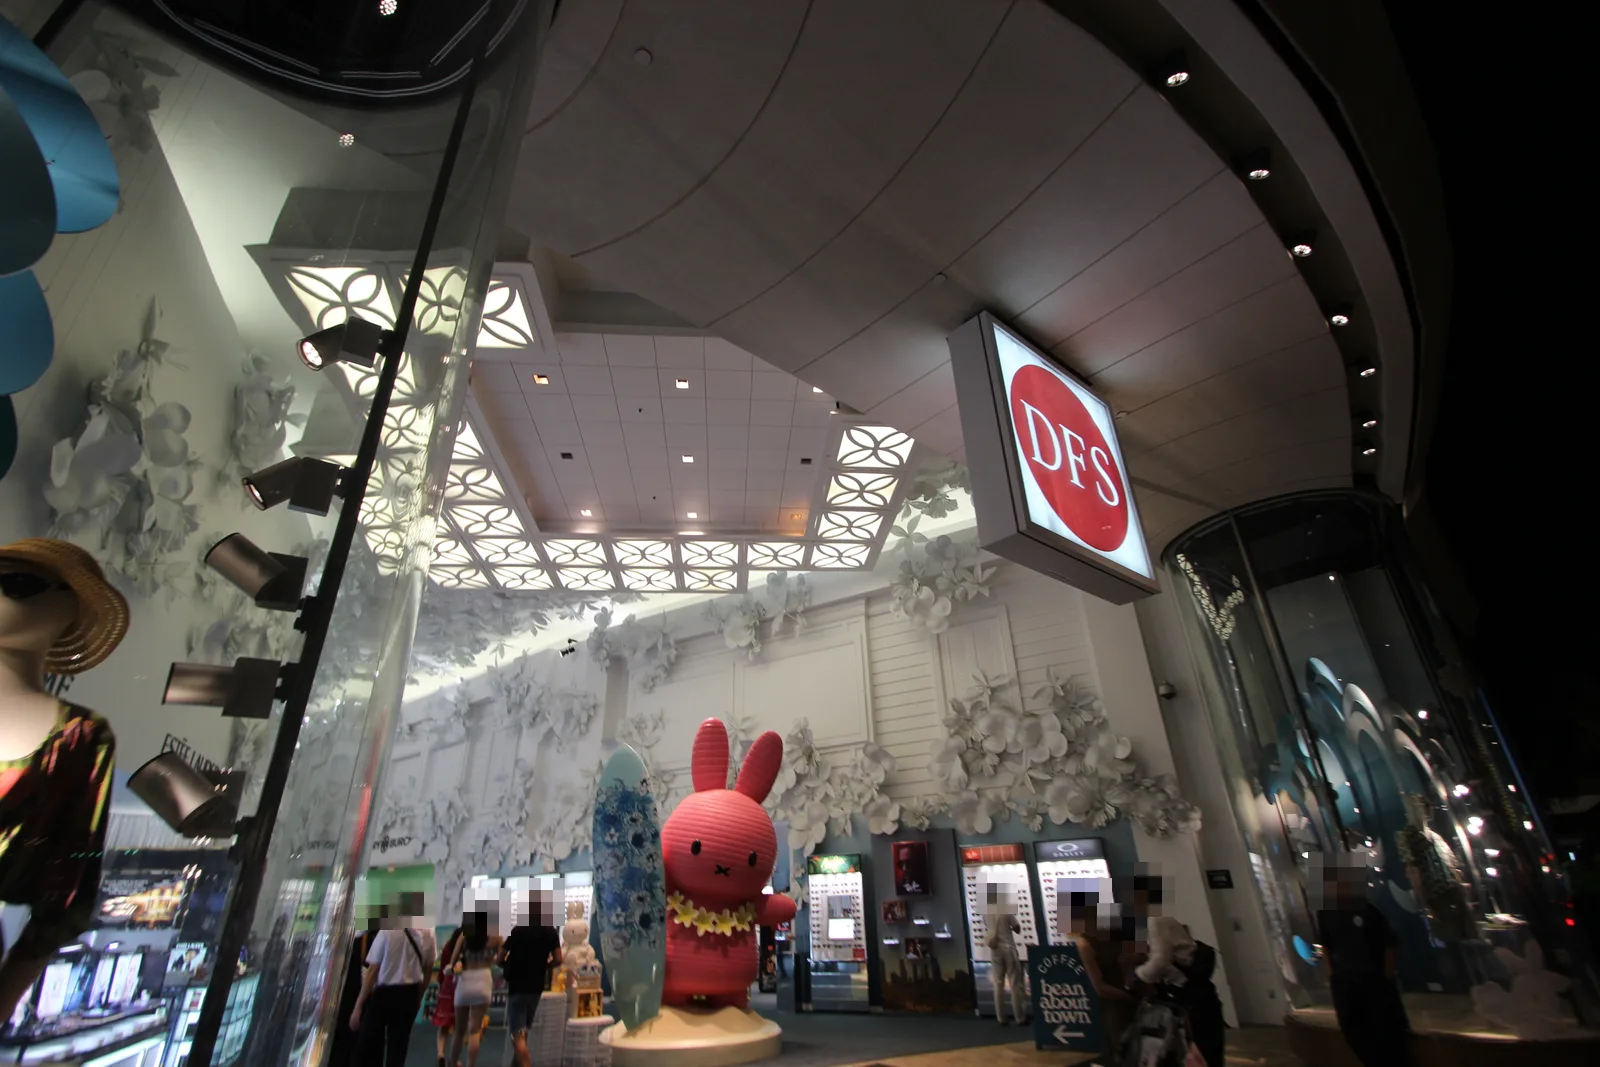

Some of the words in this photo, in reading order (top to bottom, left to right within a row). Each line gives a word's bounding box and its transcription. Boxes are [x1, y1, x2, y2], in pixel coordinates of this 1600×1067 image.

[1020, 399, 1120, 507] DFS
[1038, 954, 1084, 976] COFFEE
[1041, 979, 1086, 996] bean
[1040, 996, 1091, 1010] about
[1043, 1010, 1092, 1024] town
